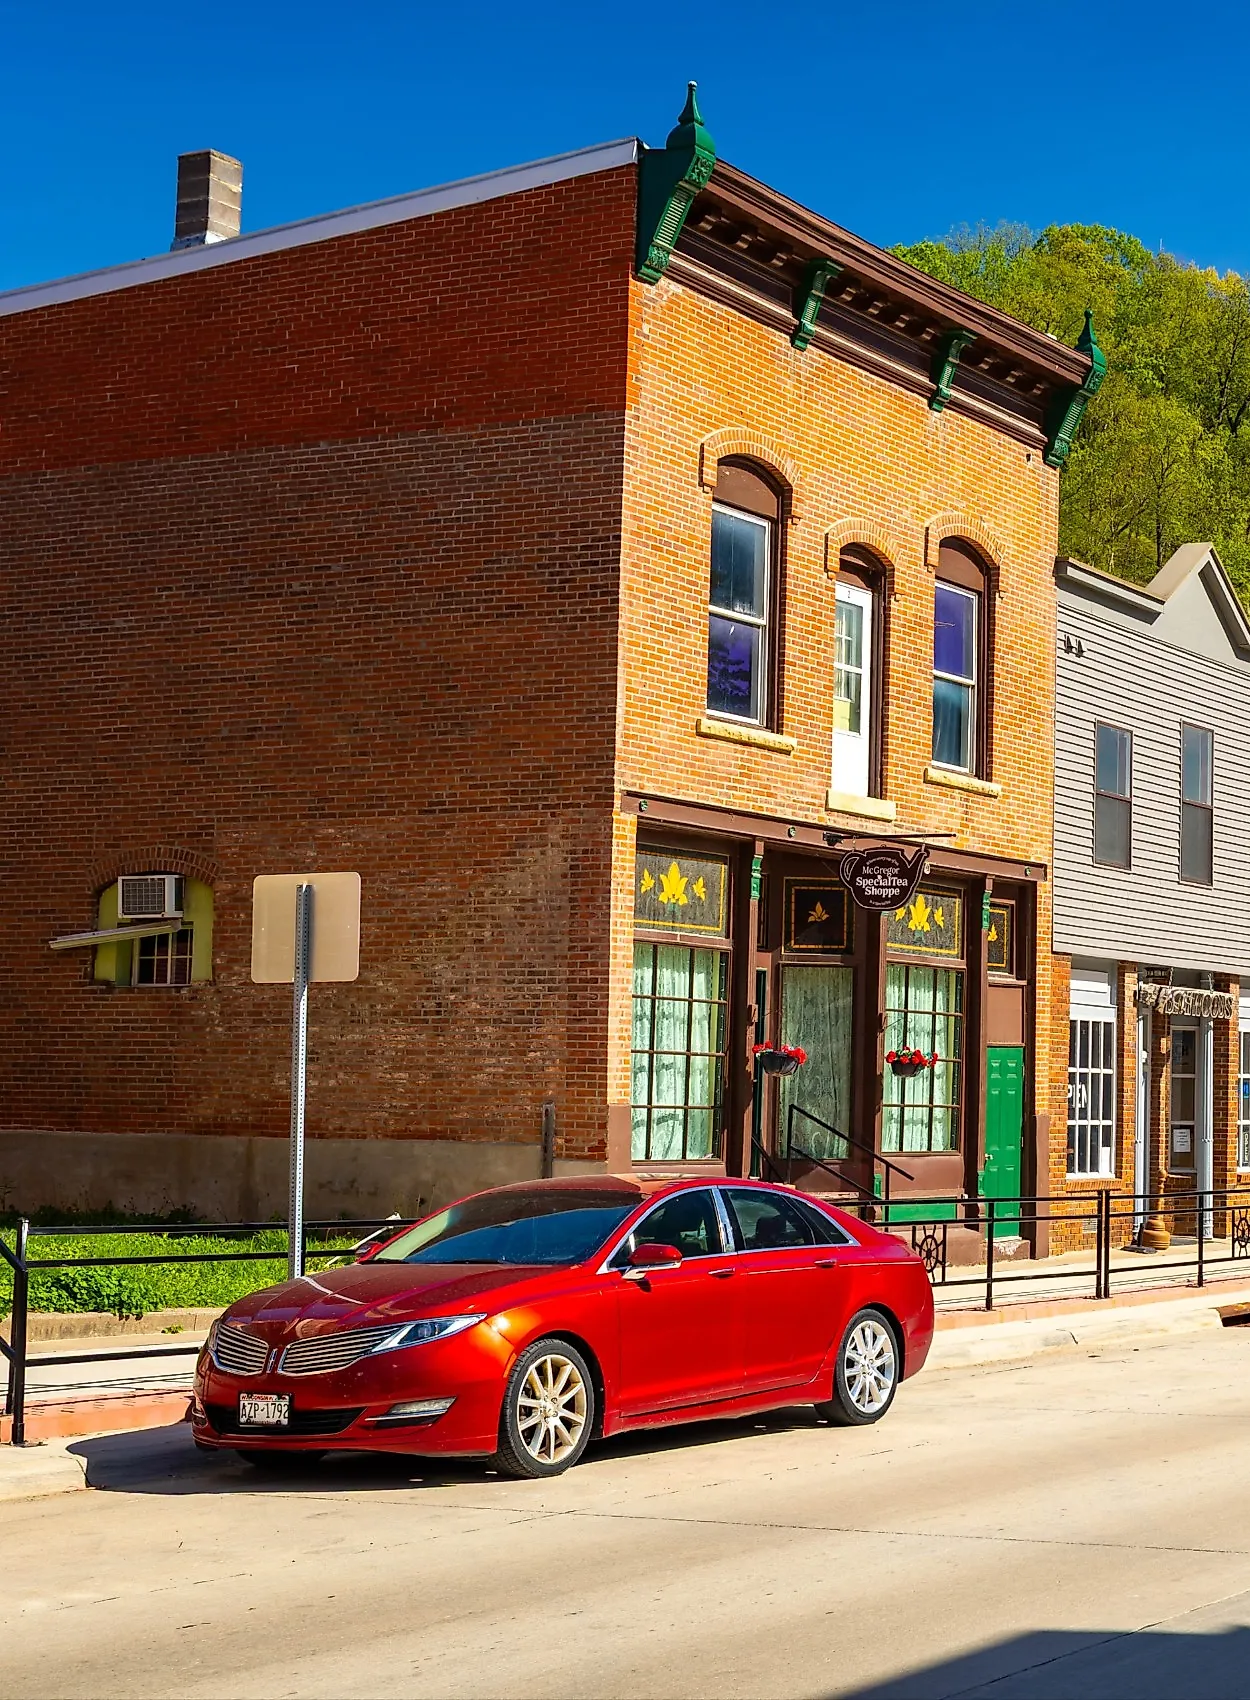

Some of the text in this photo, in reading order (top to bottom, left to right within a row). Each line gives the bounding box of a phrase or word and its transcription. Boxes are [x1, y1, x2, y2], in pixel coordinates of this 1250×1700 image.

[862, 866, 900, 879] McGregor
[855, 876, 908, 889] SpecialTea
[864, 886, 900, 898] Shoppe
[1067, 1083, 1088, 1109] PEN
